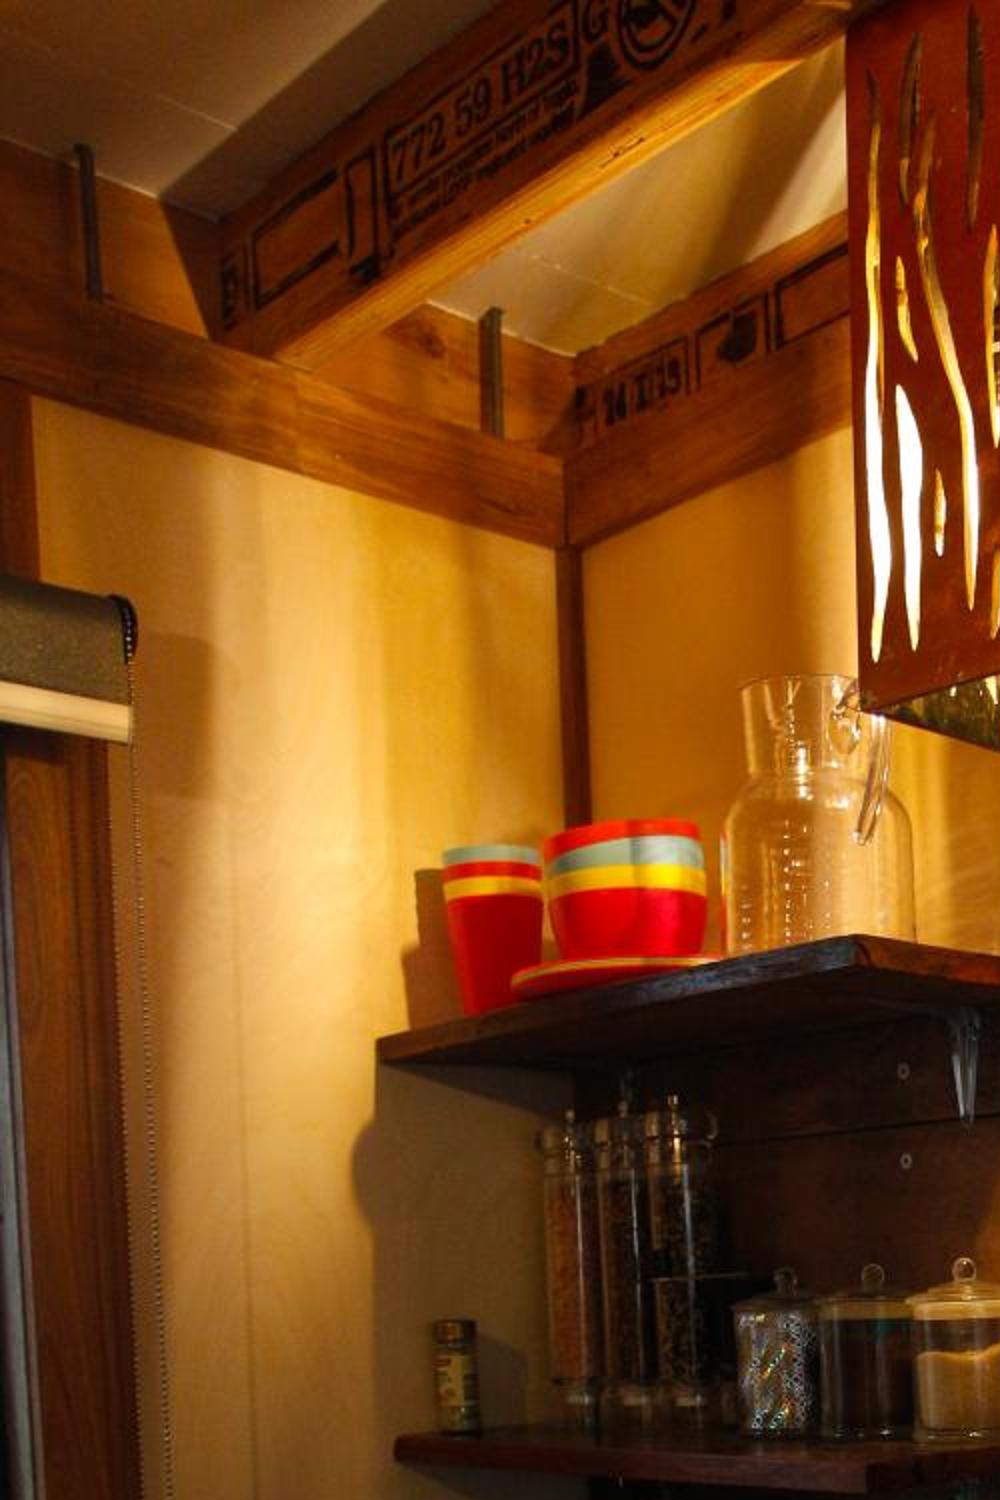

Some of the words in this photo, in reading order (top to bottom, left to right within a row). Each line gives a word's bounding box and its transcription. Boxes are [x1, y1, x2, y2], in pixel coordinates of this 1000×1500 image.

[390, 111, 446, 181] 772
[455, 75, 491, 137] 59
[501, 20, 571, 104] H2S
